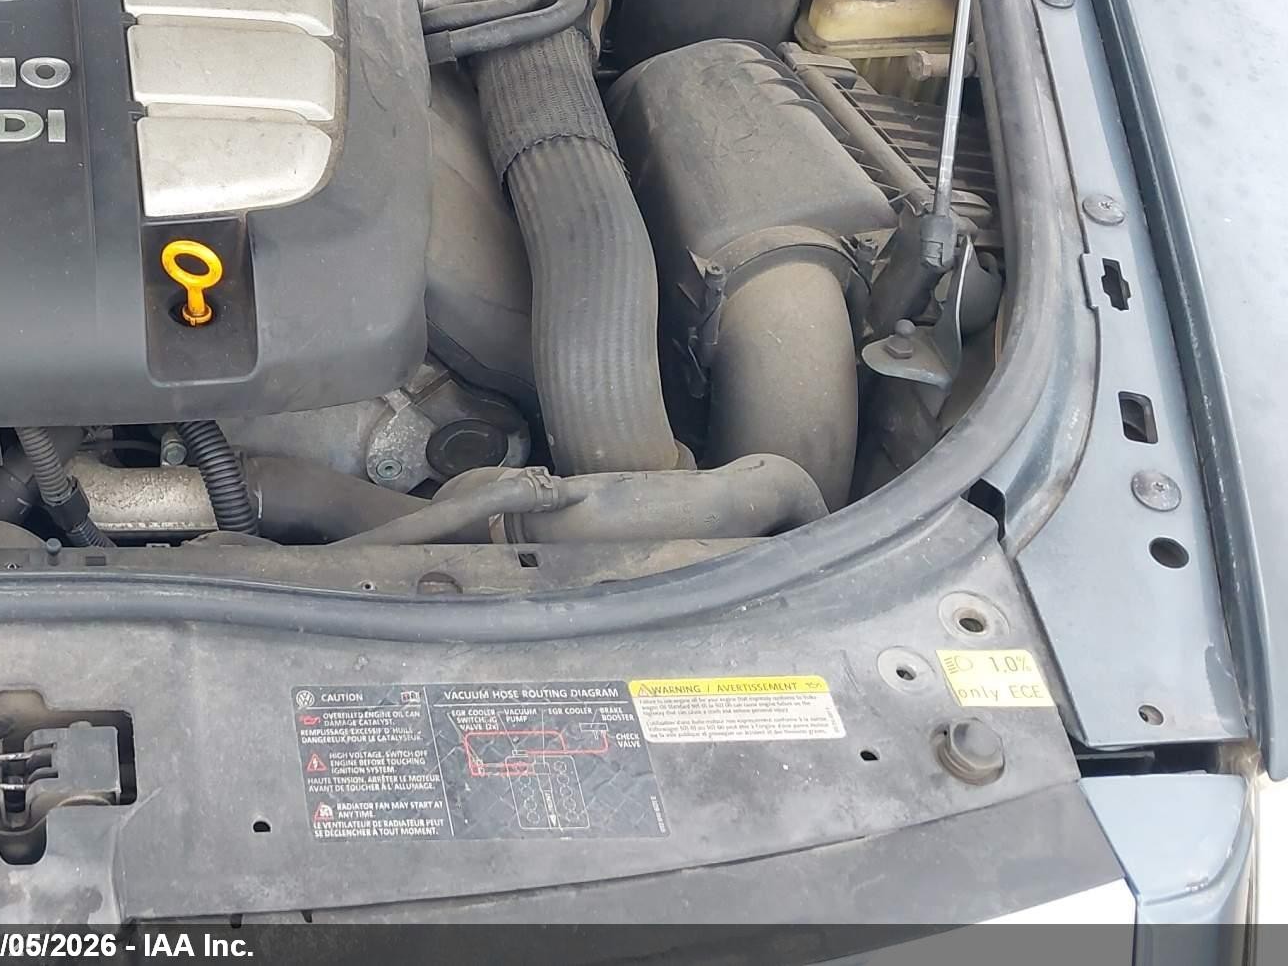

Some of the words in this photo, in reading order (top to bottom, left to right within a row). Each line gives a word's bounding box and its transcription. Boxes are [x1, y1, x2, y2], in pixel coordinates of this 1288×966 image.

[989, 656, 1033, 673] 1.0%
[650, 685, 701, 695] WARNING
[717, 682, 797, 692] AVERTISSEMENT
[444, 691, 490, 700] VACUUM
[492, 690, 520, 699] HOSE
[522, 689, 568, 699] ROUTING
[571, 688, 620, 698] DIAGRAM
[958, 686, 999, 702] only
[1009, 684, 1045, 699] ECE
[321, 693, 363, 703] CAUTION
[323, 712, 364, 720] OVERFILLED
[365, 711, 392, 719] ENGINE
[406, 710, 421, 718] CAN
[503, 708, 538, 716] VACUUM
[565, 707, 593, 715] COOLER
[324, 719, 357, 727] DAMAGE
[506, 715, 529, 723] PUMP
[347, 735, 367, 743] POUR
[616, 732, 641, 740] CHECK
[618, 740, 642, 748] VALVE
[330, 752, 349, 760] HIGH
[384, 751, 413, 759] SWITCH
[415, 750, 428, 758] OFF
[331, 759, 357, 767] ENGINE
[332, 766, 366, 774] IGNITION
[309, 785, 333, 793] AVANT
[346, 784, 380, 792] TOUCHER
[337, 803, 373, 811] RADIATOR
[375, 802, 390, 810] FAN
[391, 802, 409, 810] MAY
[411, 801, 434, 809] START
[435, 801, 444, 809] AT
[339, 810, 355, 818] ANY
[384, 819, 425, 827] RADIATEUR
[380, 827, 403, 835] TOUT
